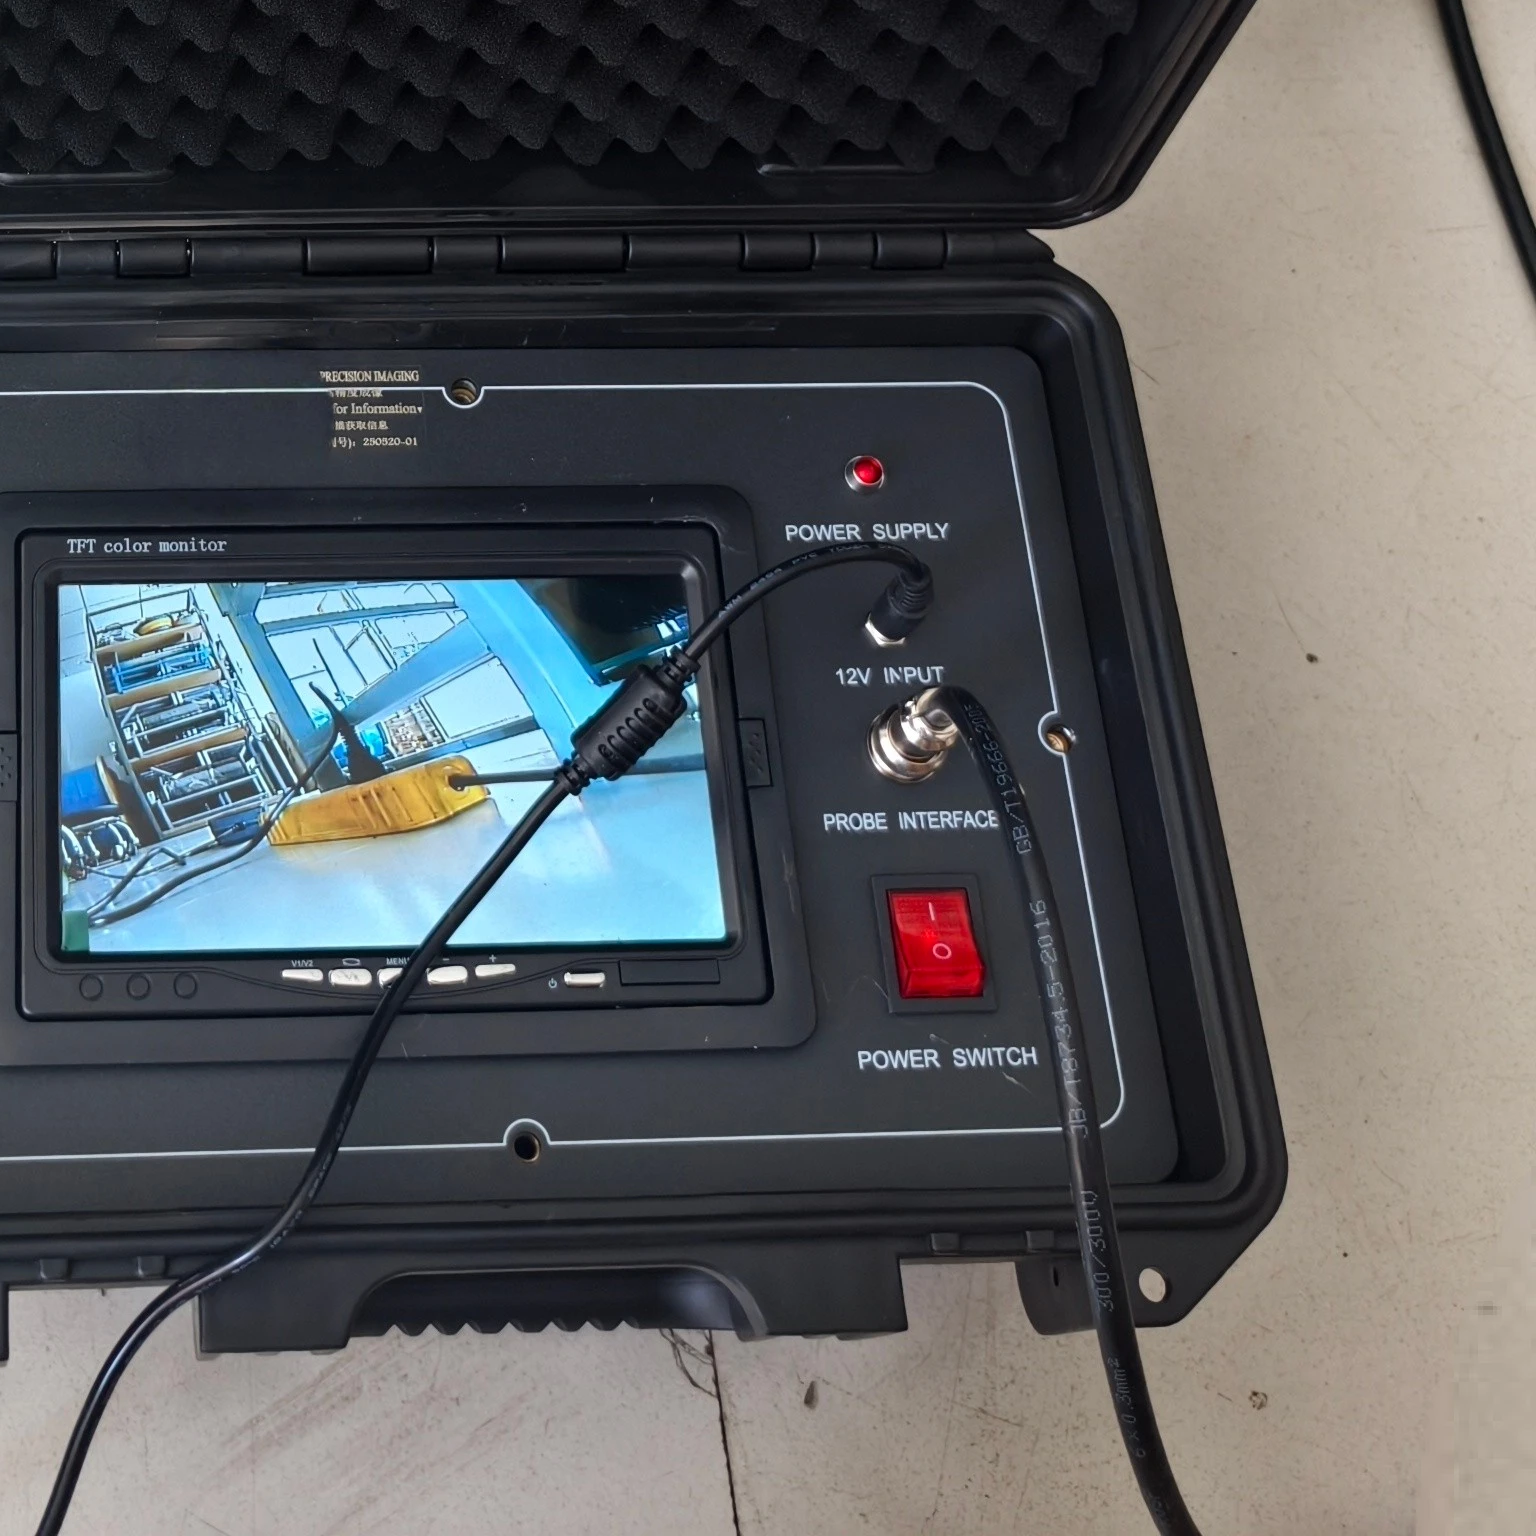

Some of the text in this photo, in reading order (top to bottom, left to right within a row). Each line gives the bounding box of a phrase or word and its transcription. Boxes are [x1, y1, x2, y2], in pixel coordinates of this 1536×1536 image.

[373, 370, 420, 382] IMAGING
[333, 402, 417, 415] for Information
[362, 436, 418, 446] 250520-01
[785, 522, 949, 542] POWER SUPPLY
[66, 536, 228, 554] TFT color monitor
[835, 666, 944, 685] 12V INPUT
[823, 809, 999, 831] PROBE INTERFACE
[857, 1046, 1038, 1070] POWER SWITCH
